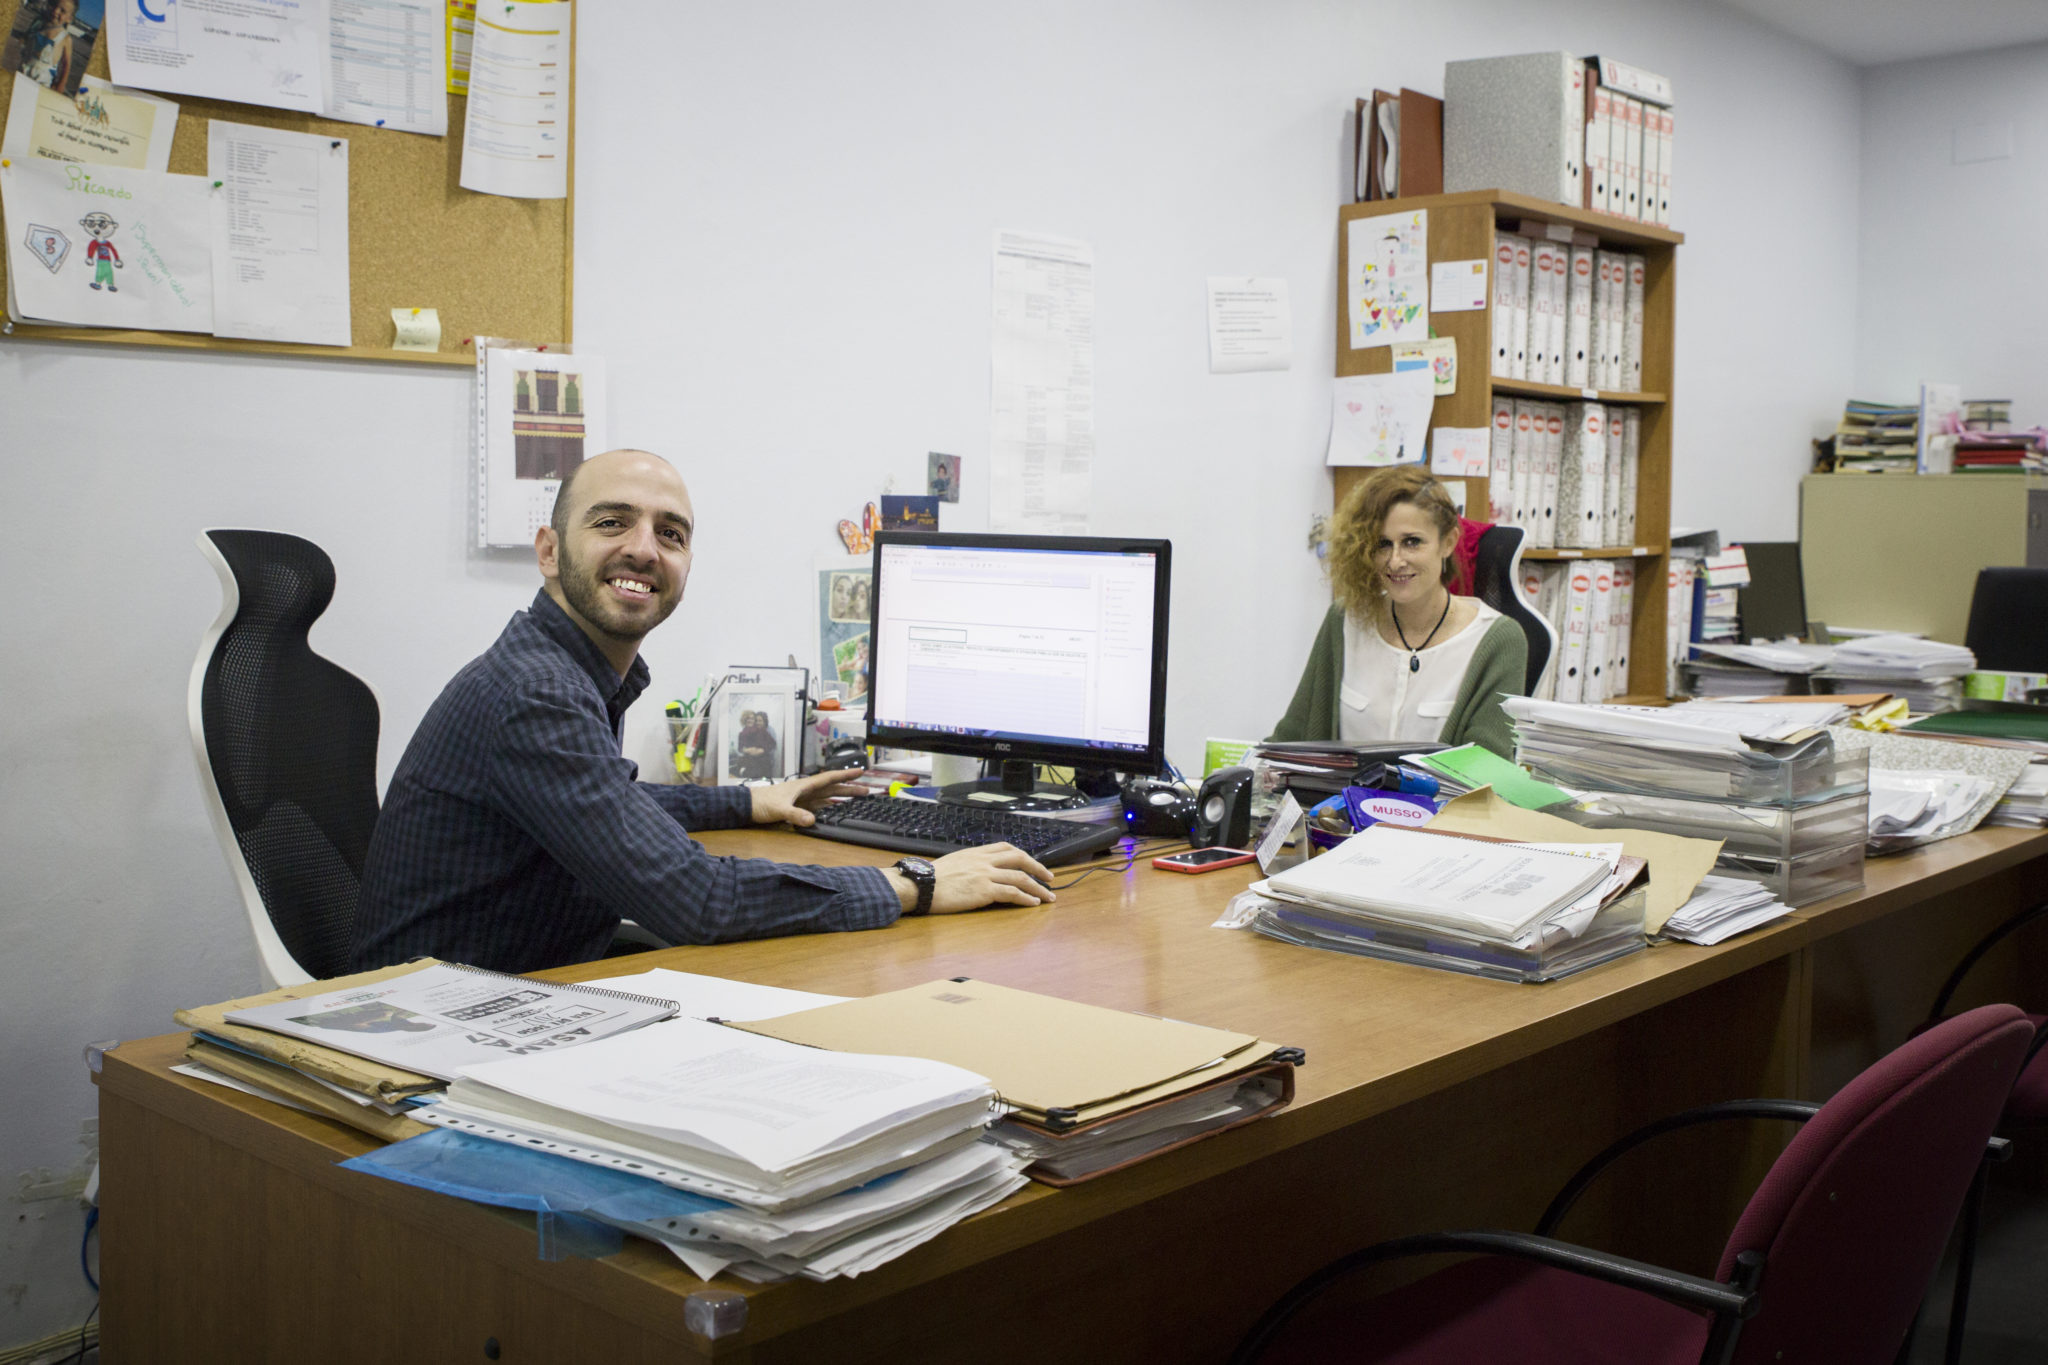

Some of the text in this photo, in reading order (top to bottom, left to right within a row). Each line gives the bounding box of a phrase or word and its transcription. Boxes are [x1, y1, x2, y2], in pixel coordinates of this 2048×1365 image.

[65, 165, 133, 200] Ricardo
[994, 742, 1011, 752] AOC
[1373, 805, 1422, 819] MUSSO
[506, 1027, 591, 1055] ASAM
